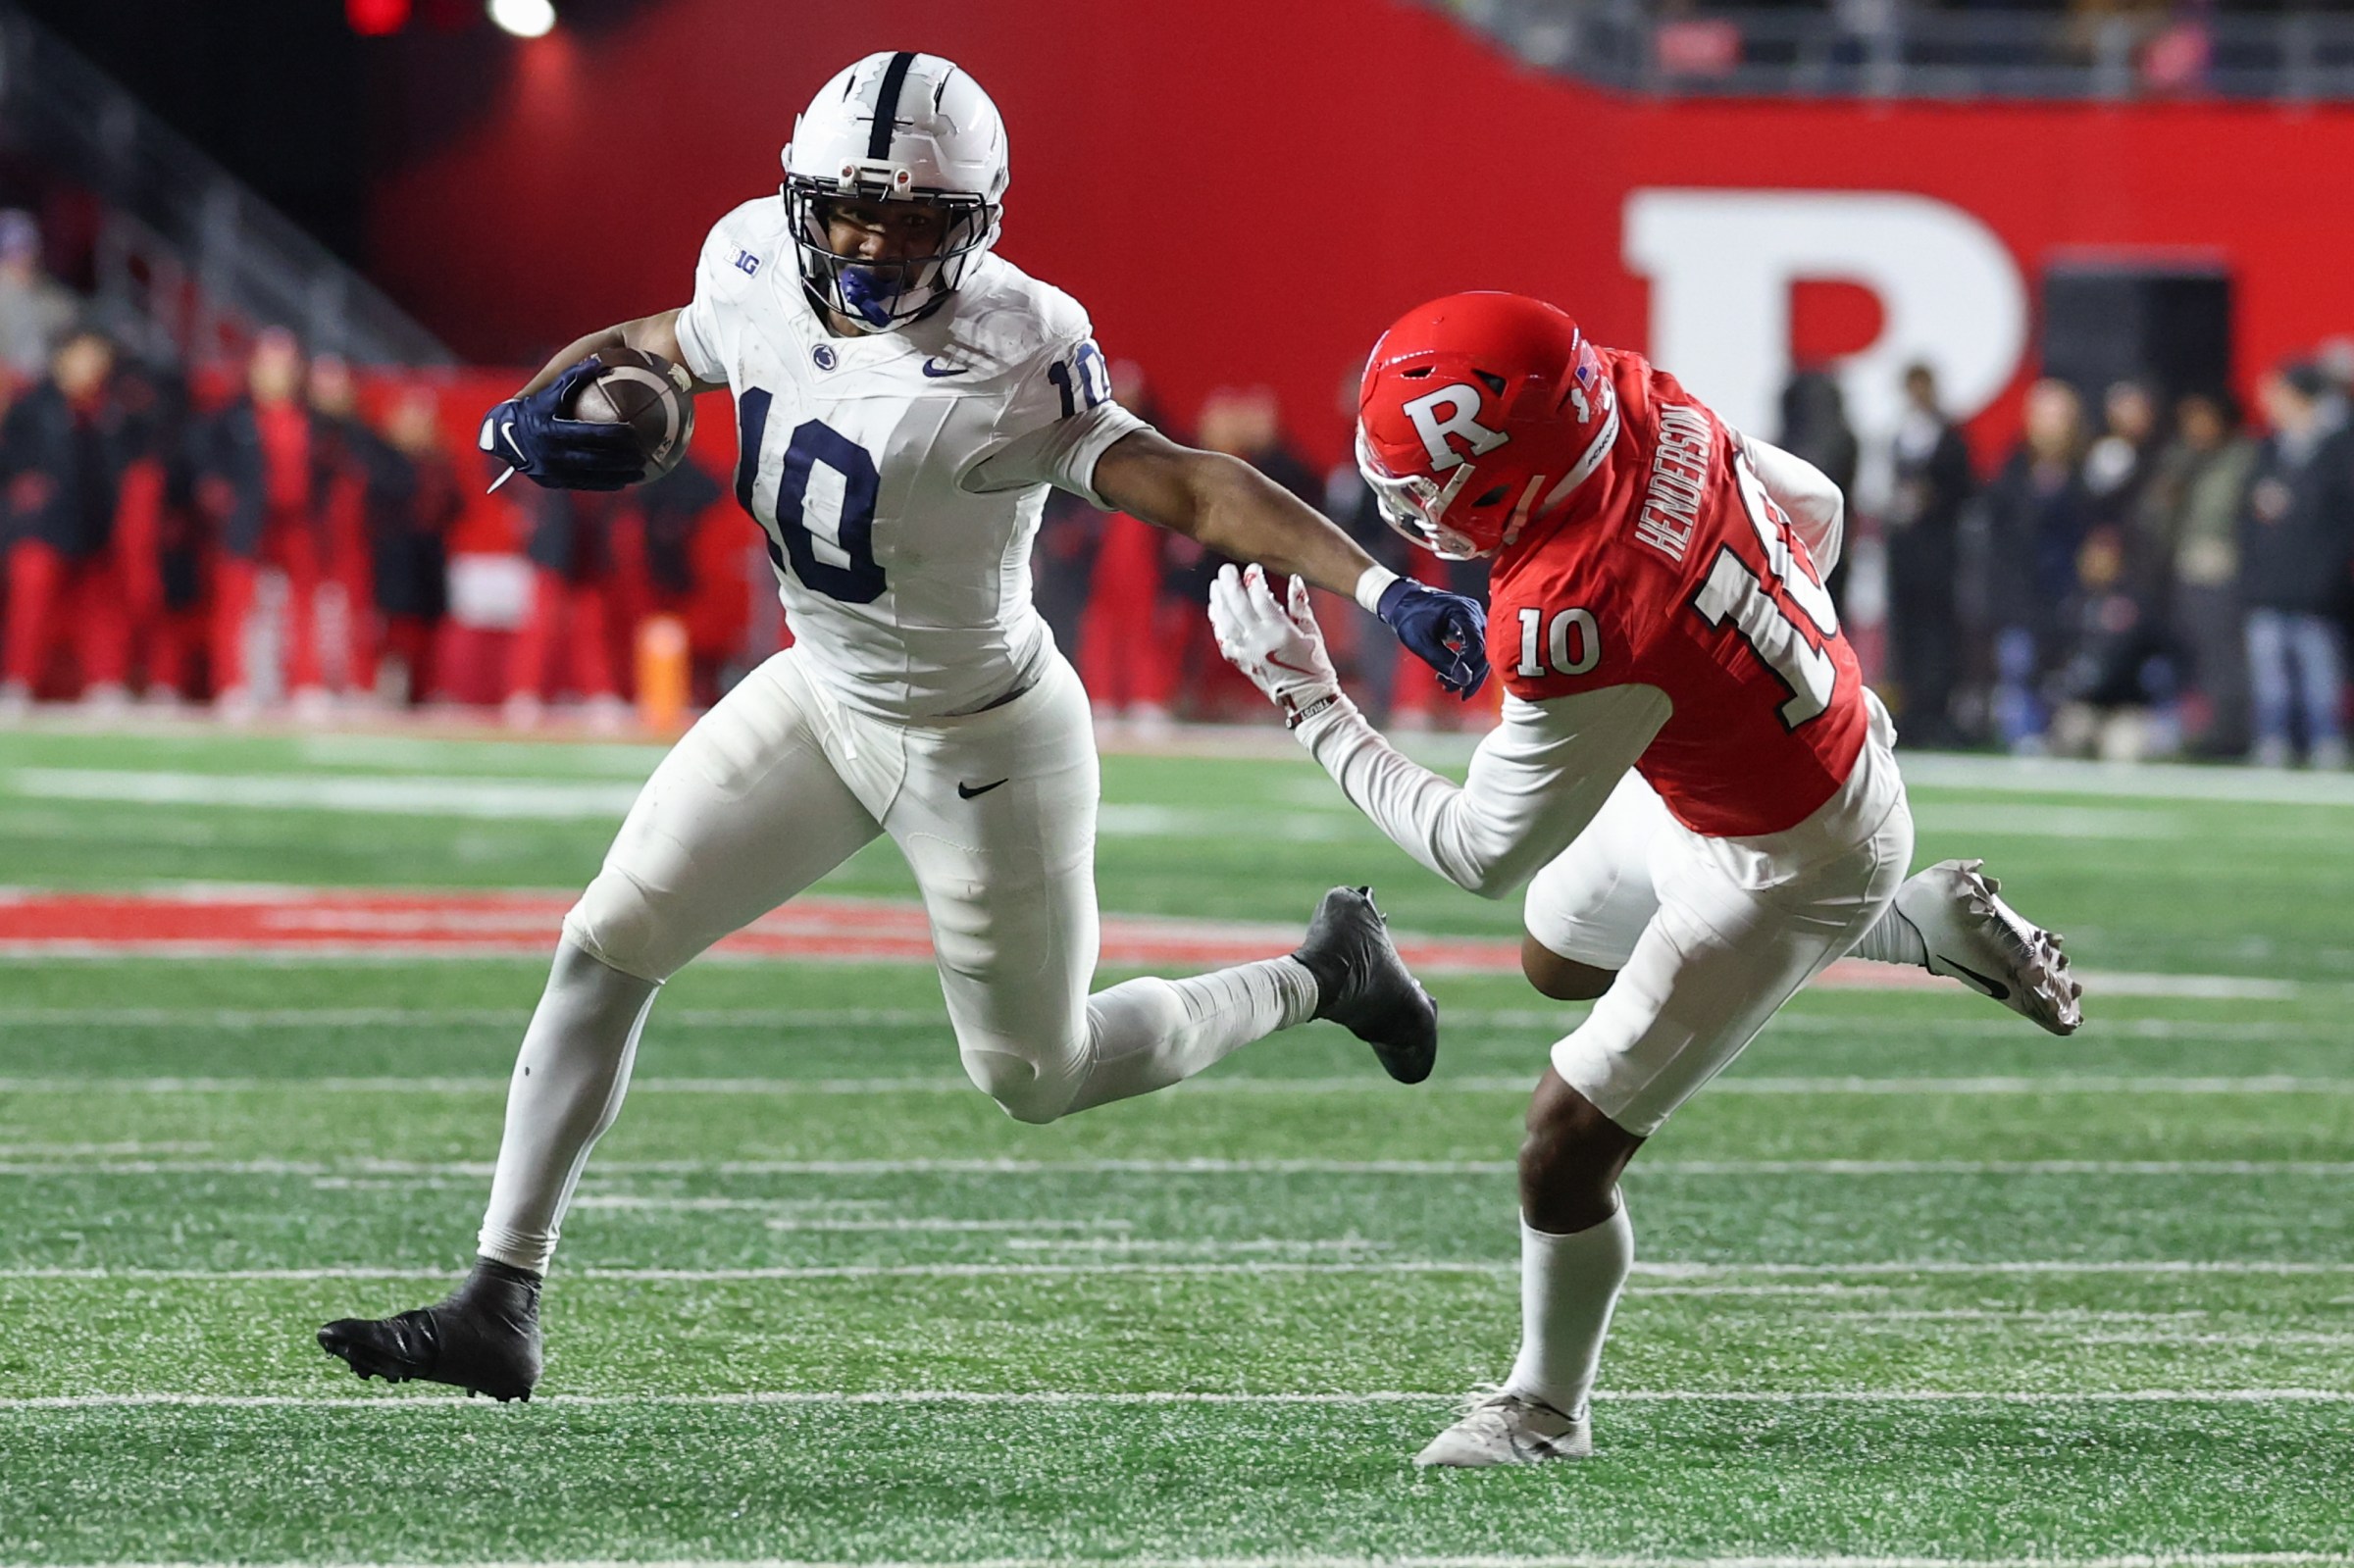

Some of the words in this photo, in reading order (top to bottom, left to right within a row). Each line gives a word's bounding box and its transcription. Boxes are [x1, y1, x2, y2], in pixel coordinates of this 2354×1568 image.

[1048, 342, 1110, 419] 10
[1621, 186, 2028, 510] R
[1403, 381, 1510, 472] R
[1634, 403, 1713, 564] HENDERSON
[736, 385, 888, 604] 10
[1516, 607, 1601, 677] 10
[1687, 446, 1839, 735] 10
[1300, 697, 1332, 722] TRUST
